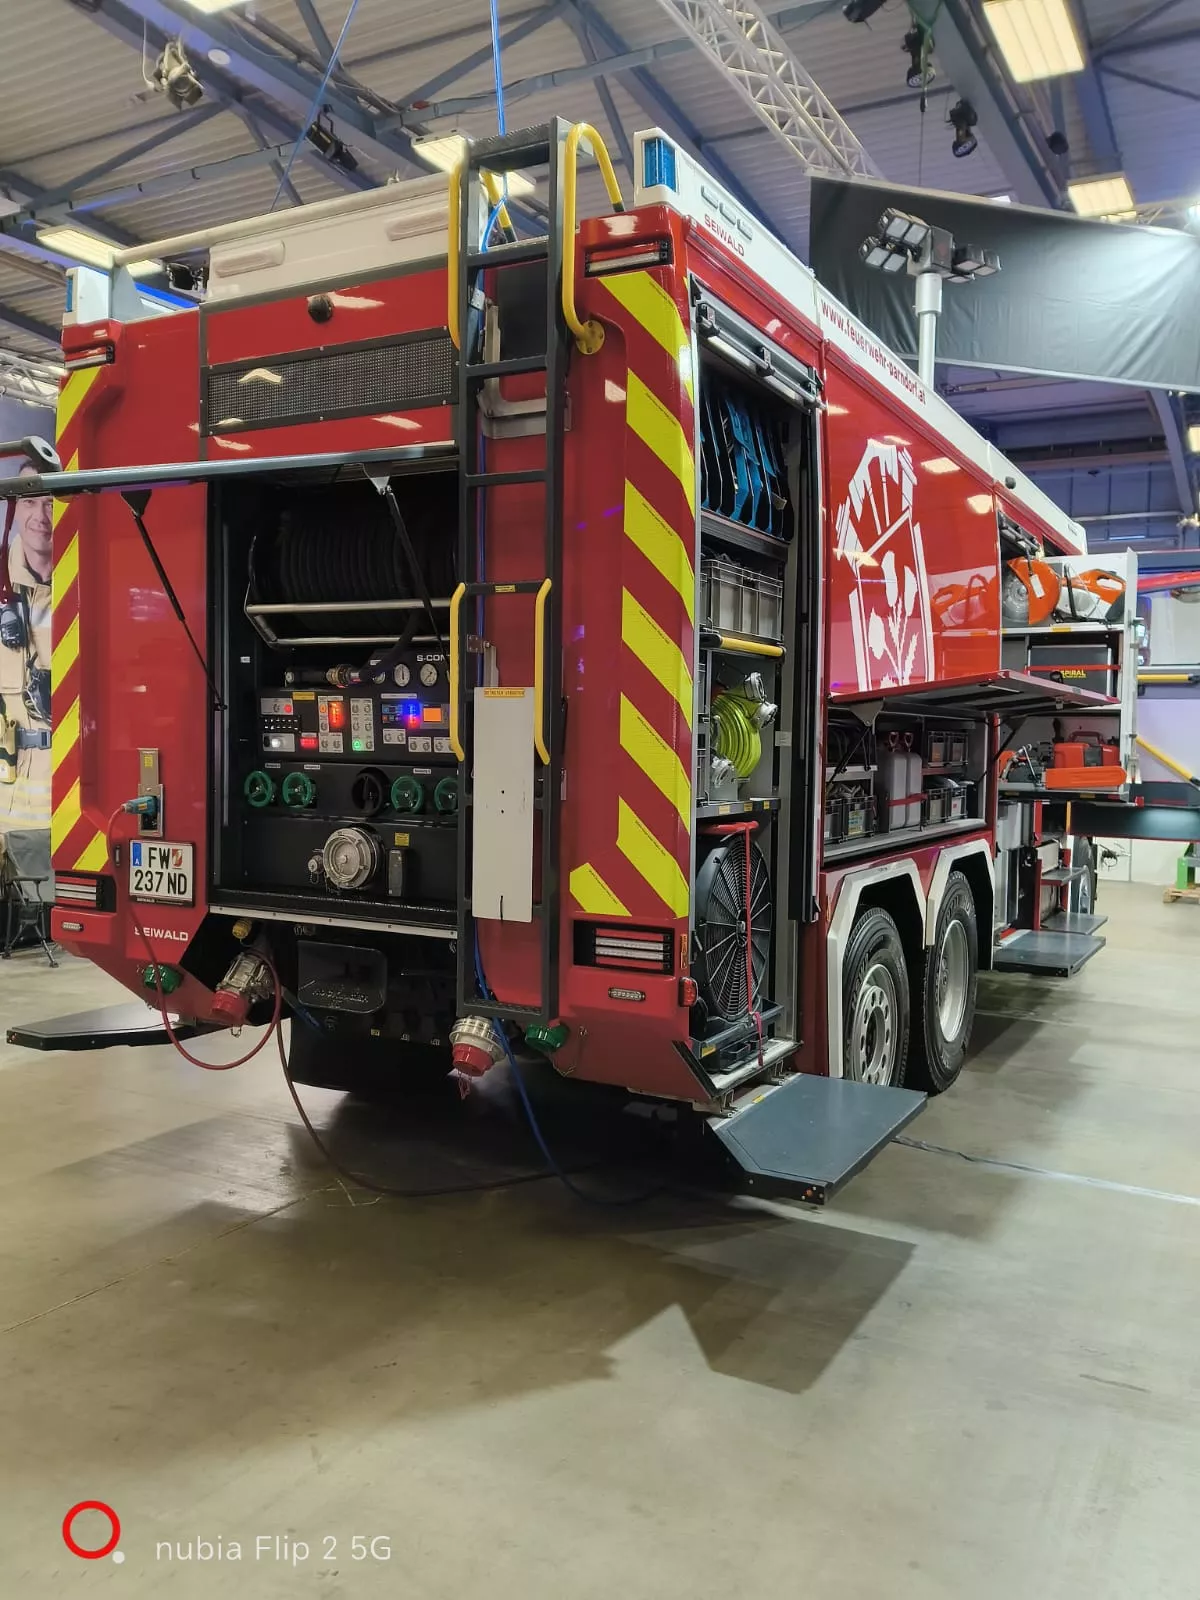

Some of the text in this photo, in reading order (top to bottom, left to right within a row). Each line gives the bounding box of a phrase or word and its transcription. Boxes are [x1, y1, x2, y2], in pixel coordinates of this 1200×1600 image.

[704, 213, 745, 257] SEIWALD
[820, 298, 927, 406] www.feuerwehr-parndorf.at
[148, 847, 171, 869] FW
[134, 869, 187, 896] 237 ND
